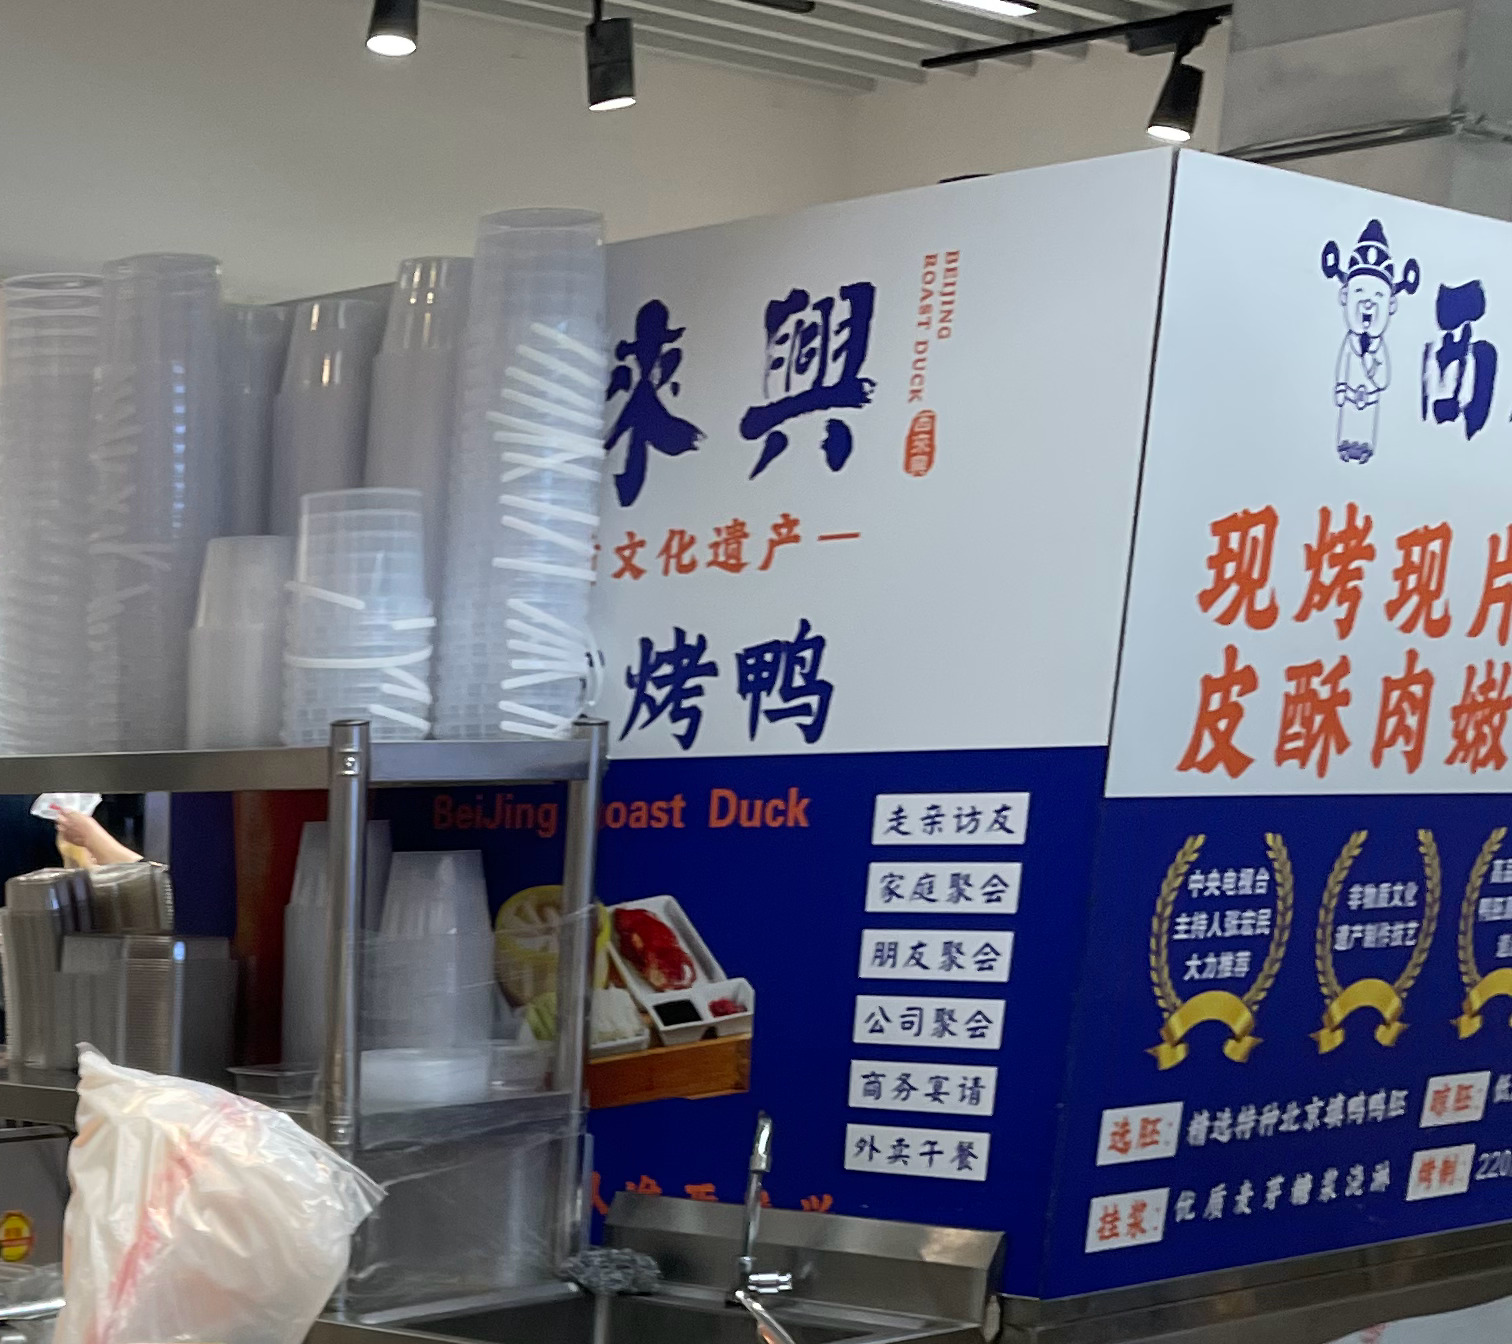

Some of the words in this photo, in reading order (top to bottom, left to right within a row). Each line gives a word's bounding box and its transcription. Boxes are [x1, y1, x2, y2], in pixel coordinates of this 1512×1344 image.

[918, 253, 940, 329] ROAST
[938, 250, 960, 340] BEIJING
[908, 340, 929, 403] DUCK
[586, 618, 834, 750] 烤鸭
[1176, 643, 1512, 779] 皮酥肉嫩
[433, 794, 558, 837] BeiJing
[599, 793, 686, 829] oast
[708, 787, 811, 828] Duck
[882, 804, 1015, 836] 走亲访友
[880, 872, 1010, 904] 家庭聚会
[1187, 867, 1270, 898] 中央电视台
[871, 940, 1001, 972] 朋友聚会
[864, 1005, 993, 1039] 公司聚会
[861, 1071, 986, 1106] 商务宴请
[853, 1135, 978, 1171] 外卖午餐
